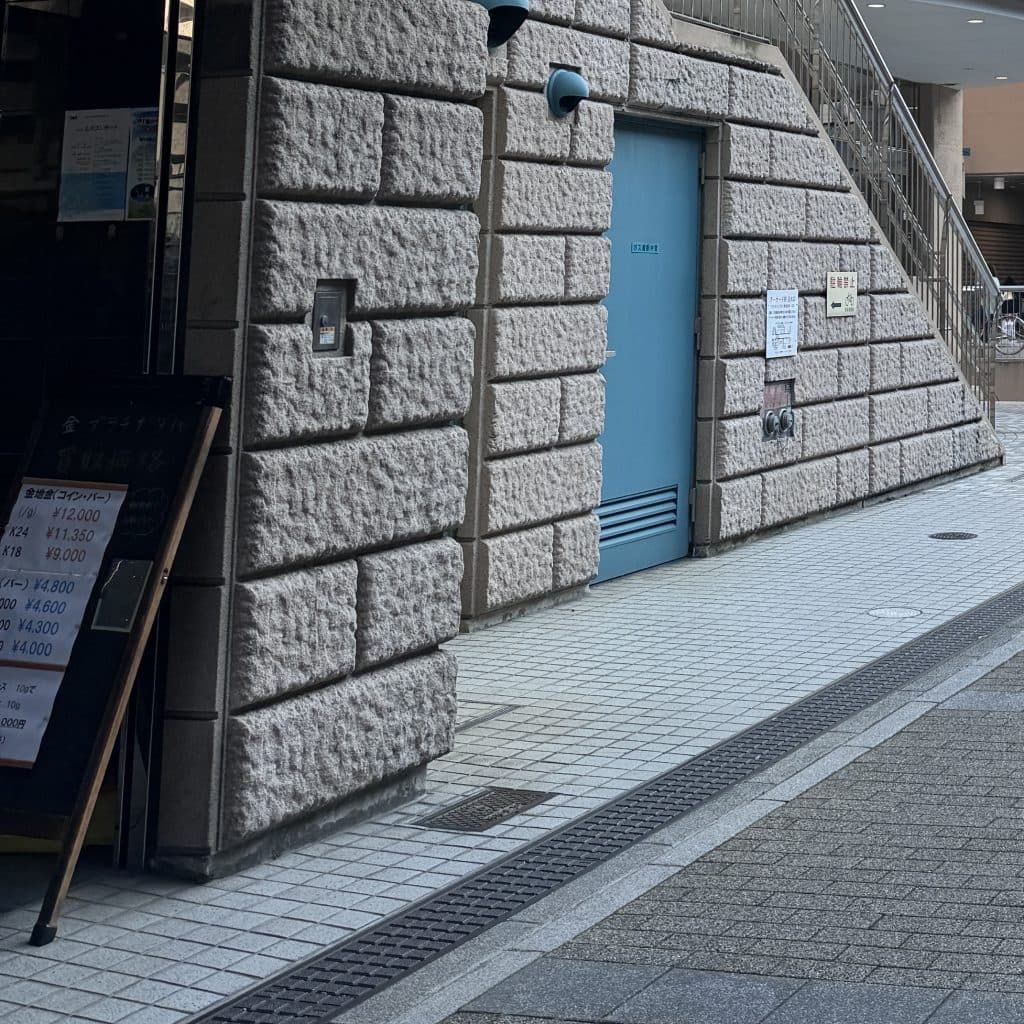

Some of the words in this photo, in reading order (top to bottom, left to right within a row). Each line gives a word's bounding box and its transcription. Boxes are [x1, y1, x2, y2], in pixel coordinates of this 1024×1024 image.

[24, 488, 112, 504] 金地金(コイン・バー)
[9, 526, 29, 538] K24
[2, 545, 22, 558] K18
[33, 577, 75, 594] ¥4,800
[25, 598, 67, 615] ¥4,600
[17, 618, 60, 636] ¥4,300
[12, 640, 53, 657] ¥4,000
